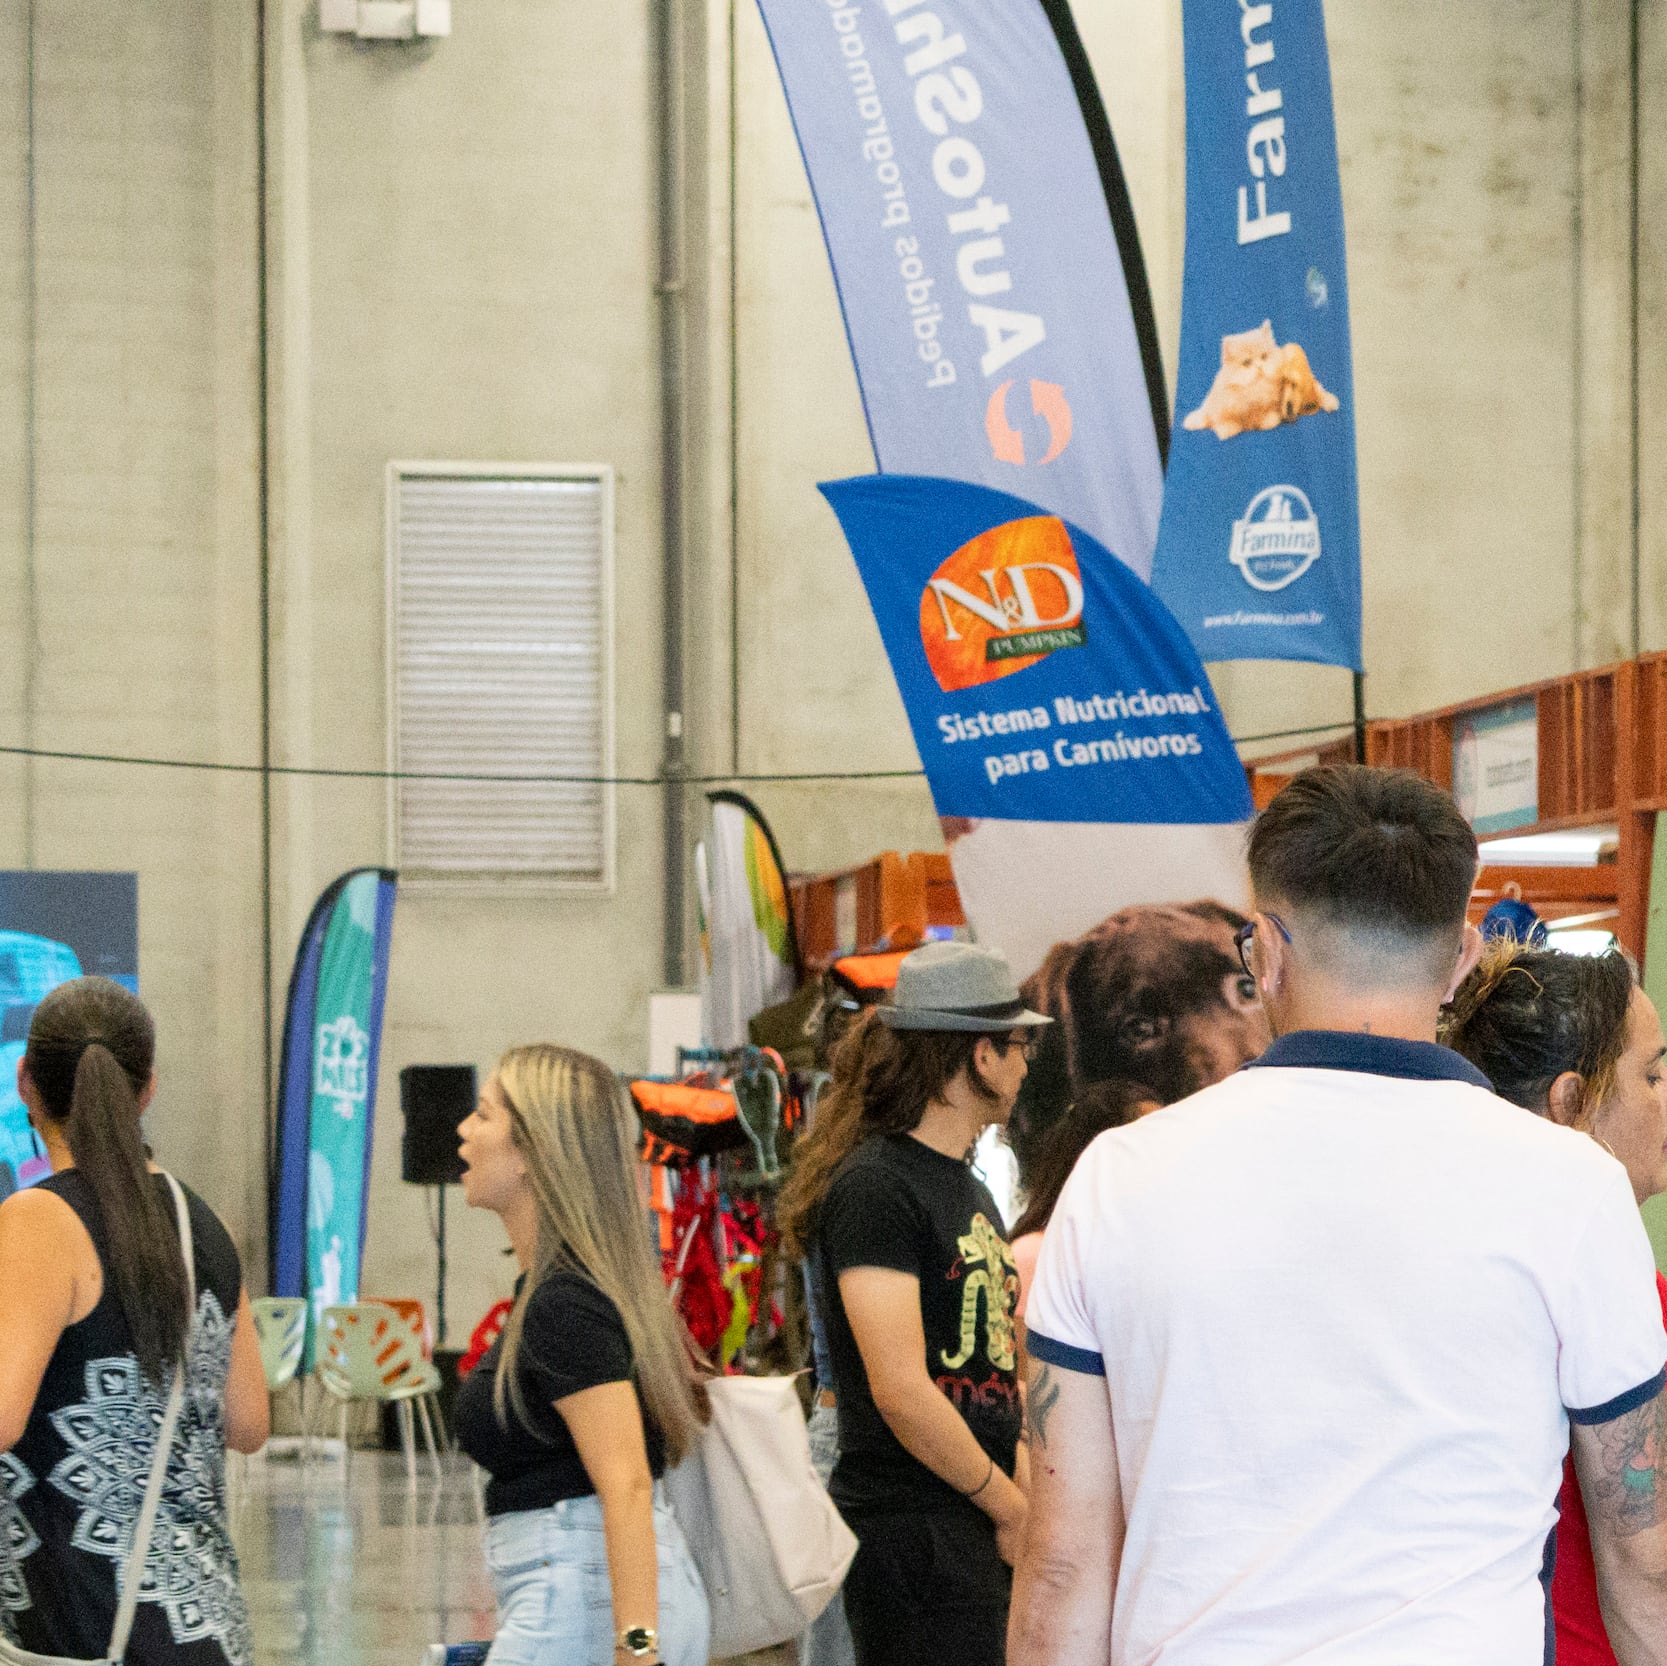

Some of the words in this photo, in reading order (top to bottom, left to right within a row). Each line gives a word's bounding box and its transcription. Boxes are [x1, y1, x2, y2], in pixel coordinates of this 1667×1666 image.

[1239, 528, 1317, 554] Farmina
[937, 701, 1051, 744] Sistema
[1055, 686, 1211, 725] Nutricional
[984, 751, 1051, 785] para
[1053, 730, 1203, 769] Carnívoros
